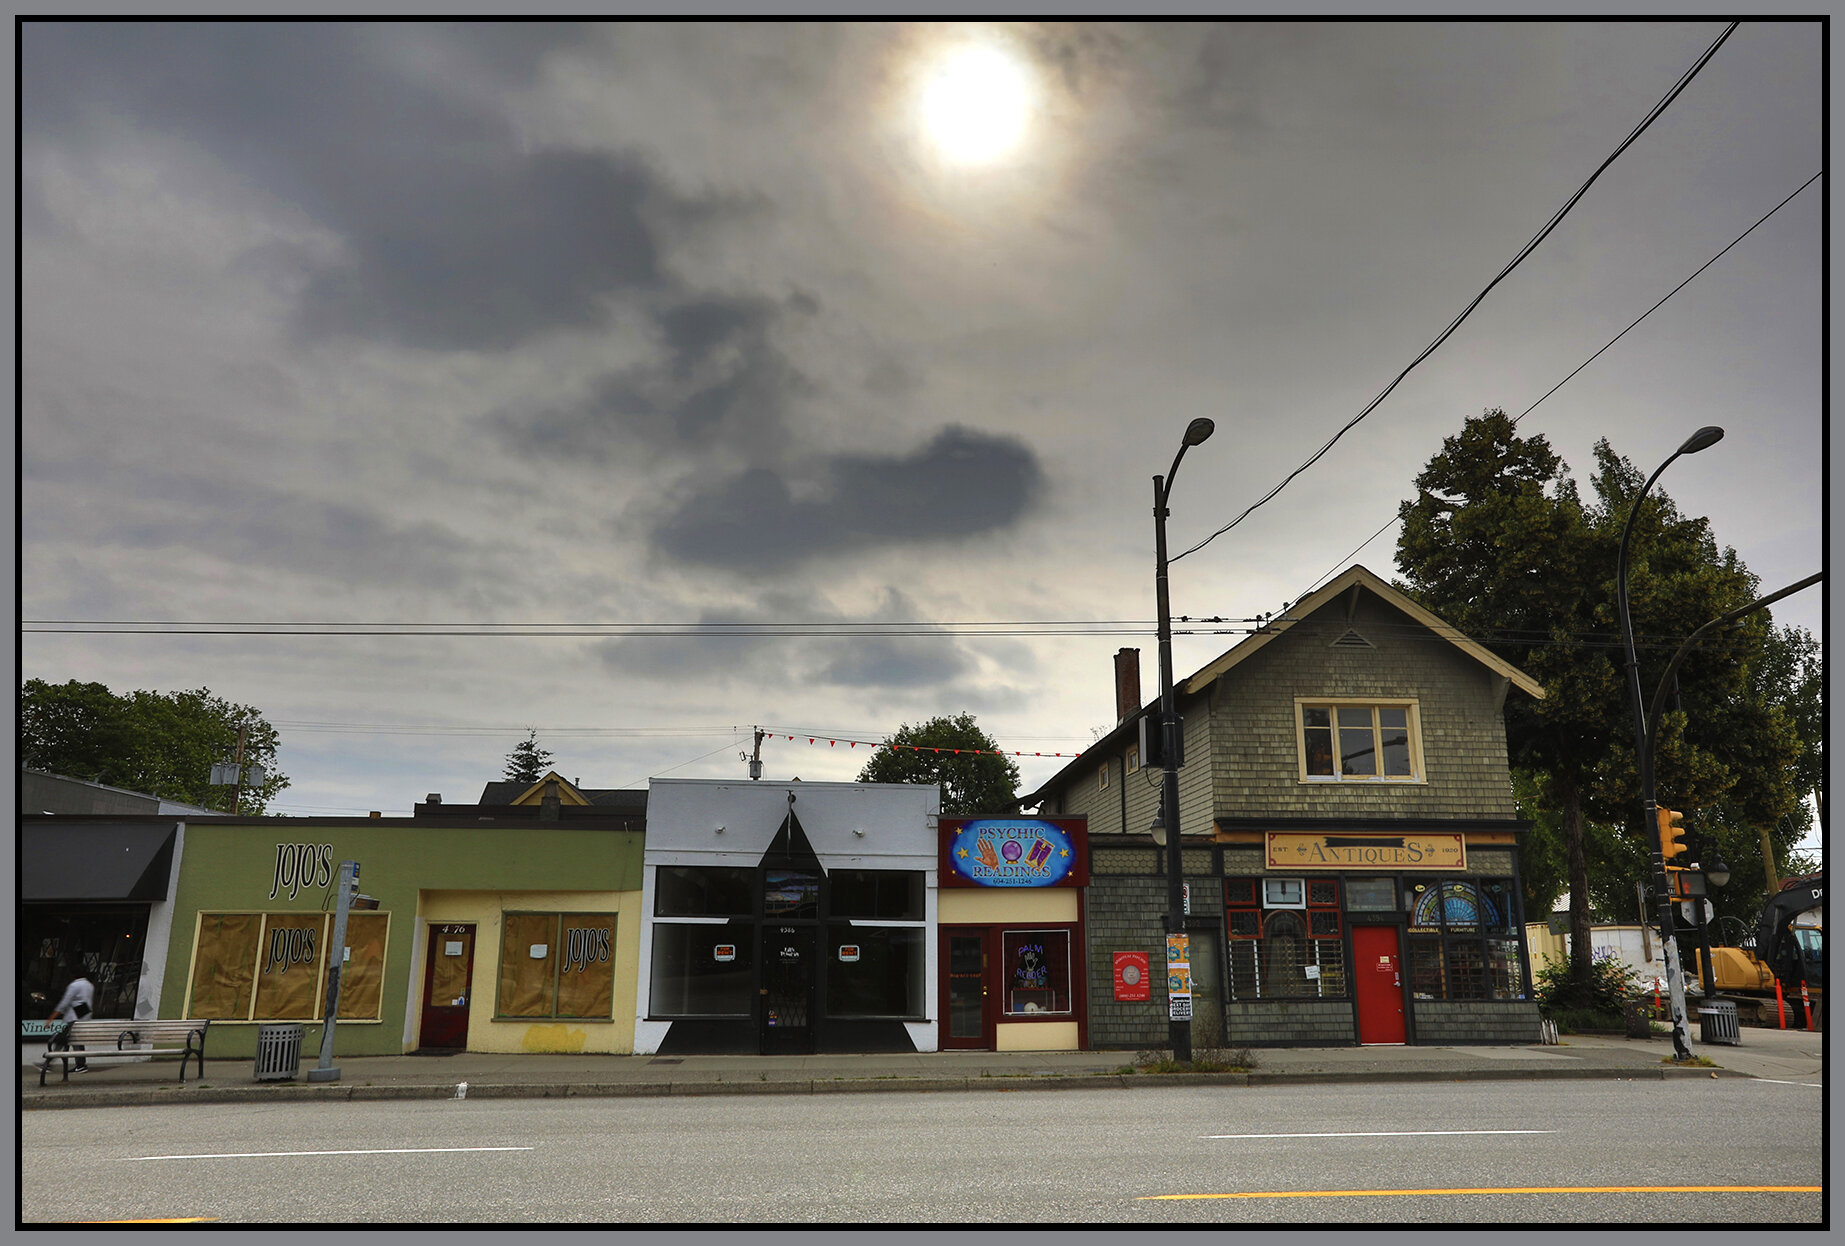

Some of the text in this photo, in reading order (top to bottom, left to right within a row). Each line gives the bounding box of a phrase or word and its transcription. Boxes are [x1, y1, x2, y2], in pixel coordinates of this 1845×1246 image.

[979, 827, 1045, 839] PSYCHIC
[1308, 842, 1423, 864] ANTIQUES
[269, 843, 334, 900] JOJO'S
[973, 866, 1051, 878] READINGS
[264, 928, 316, 974] JOJO'S
[563, 928, 610, 973] JOJO'S
[1018, 944, 1043, 957] PALM
[1016, 965, 1047, 980] READER
